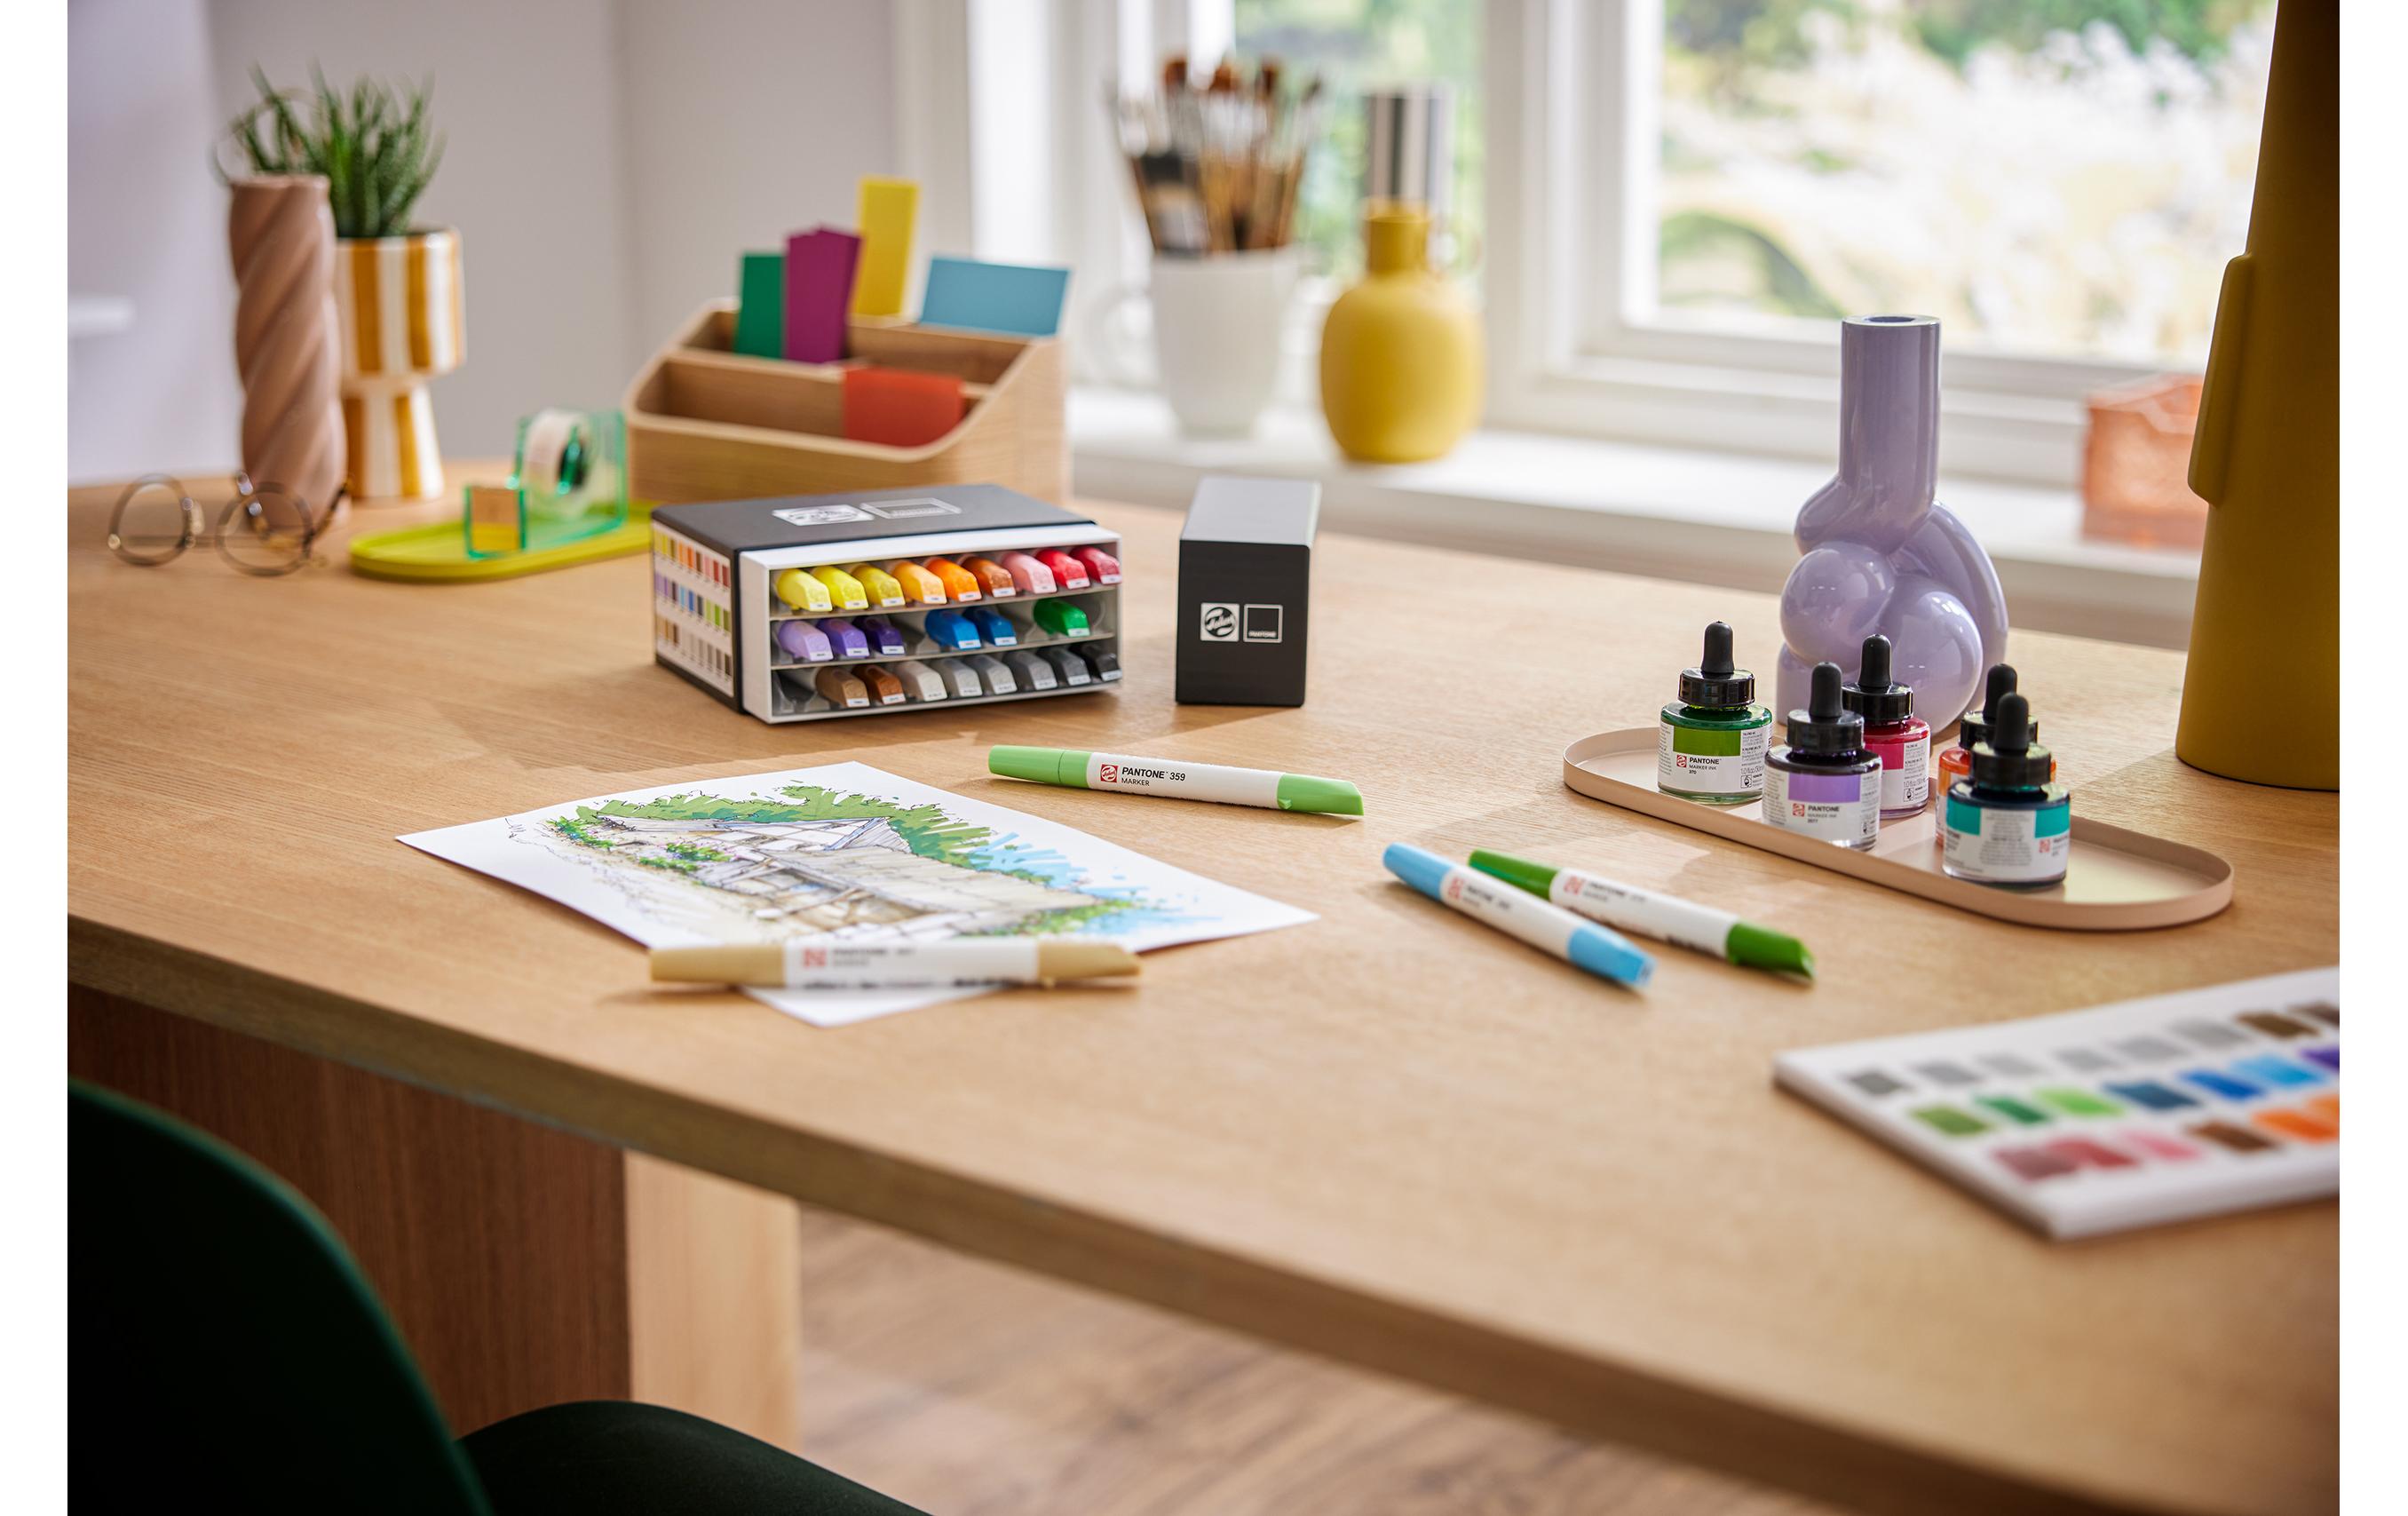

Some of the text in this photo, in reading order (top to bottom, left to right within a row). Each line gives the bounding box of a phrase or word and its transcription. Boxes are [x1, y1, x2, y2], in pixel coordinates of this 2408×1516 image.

[1121, 766, 1186, 782] PANTONE 359
[1121, 778, 1150, 787] MARKER
